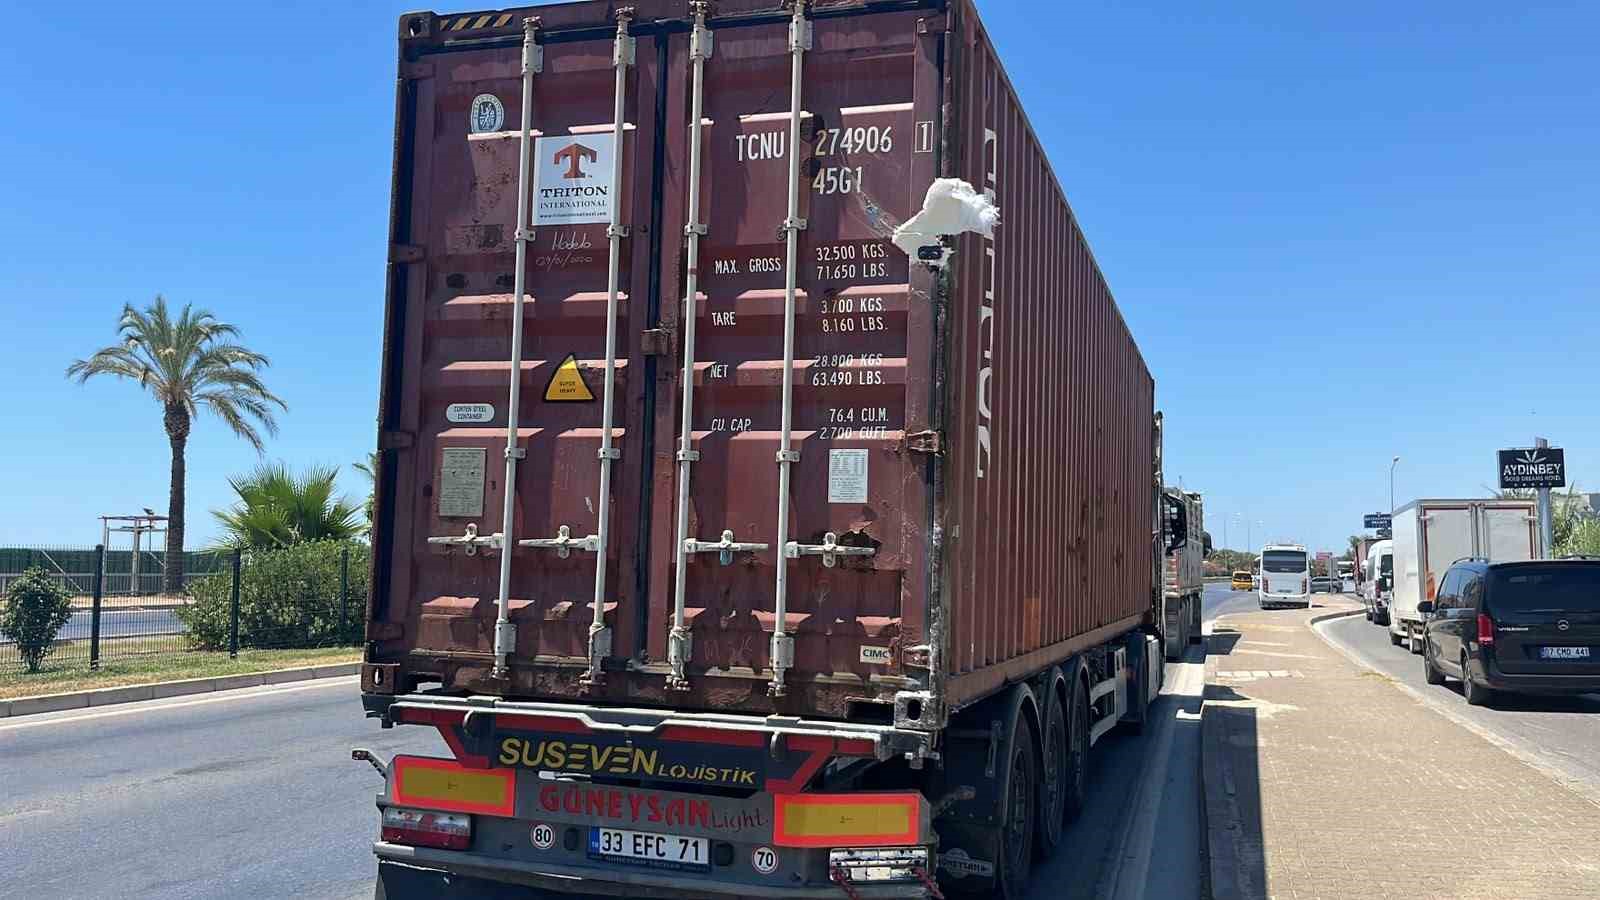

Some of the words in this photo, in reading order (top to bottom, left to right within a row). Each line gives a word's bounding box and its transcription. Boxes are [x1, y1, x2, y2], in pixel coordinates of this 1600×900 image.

[736, 131, 785, 161] TCNU
[815, 126, 892, 156] 274906
[921, 123, 928, 150] 1
[812, 166, 863, 195] 45G1
[540, 186, 608, 199] TRITON
[540, 200, 607, 210] INTERNATIONAL
[715, 260, 740, 274] MAX.
[749, 258, 782, 273] GROSS
[816, 245, 856, 261] 32.500
[862, 244, 889, 259] KGS.
[817, 265, 856, 280] 71.650
[863, 263, 889, 278] LBS.
[711, 312, 736, 326] TARE
[821, 299, 853, 314] 3.700
[860, 297, 887, 312] KGS.
[823, 317, 854, 332] 8.160
[861, 316, 888, 331] LBS.
[710, 365, 729, 378] NET
[814, 354, 853, 368] 28.800
[812, 372, 852, 386] 63.490
[860, 371, 886, 385] LBS.
[711, 418, 727, 432] CU.
[829, 408, 854, 423] 76.4
[861, 407, 889, 422] CU.M.
[819, 426, 853, 440] 2.700
[1503, 463, 1561, 476] AYDINBEY
[863, 648, 889, 660] CIMC
[499, 737, 658, 775] SUSEVEN
[538, 783, 711, 828] GÜNEYSAN
[534, 829, 552, 844] 80
[602, 832, 623, 852] 33
[633, 837, 667, 858] EFC
[679, 839, 700, 862] 71
[757, 851, 774, 867] 70
